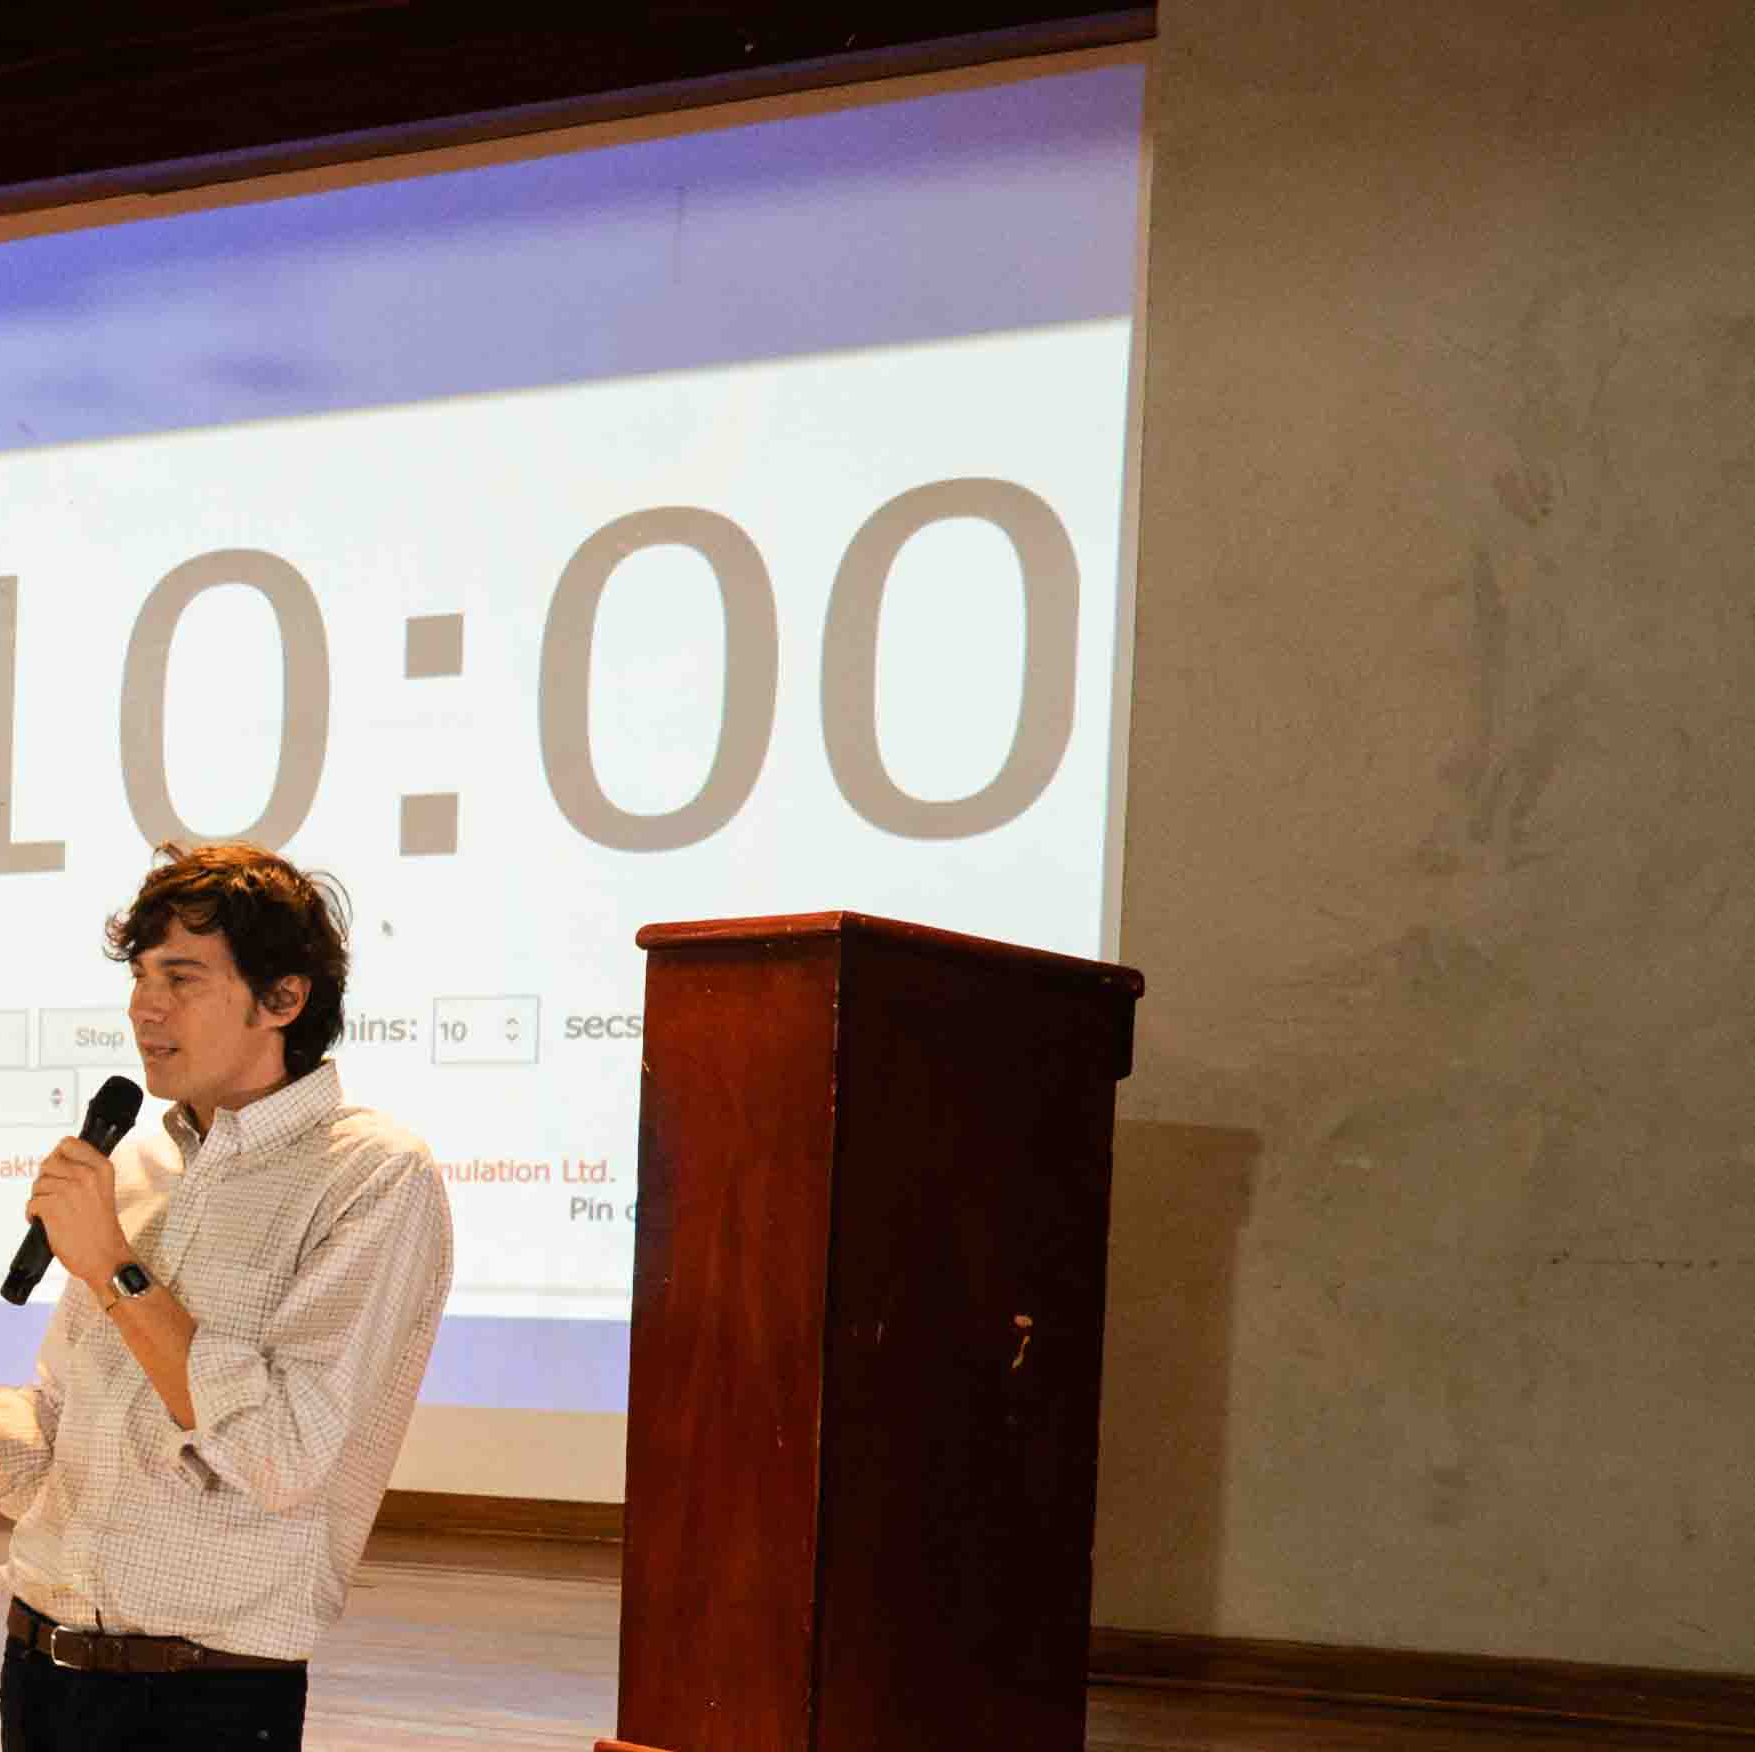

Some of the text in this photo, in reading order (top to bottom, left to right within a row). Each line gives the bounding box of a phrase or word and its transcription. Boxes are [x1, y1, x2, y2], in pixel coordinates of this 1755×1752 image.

[73, 1025, 128, 1051] Stop
[438, 1018, 470, 1045] 10
[560, 1157, 618, 1186] Ltd.
[568, 1193, 616, 1223] Pin
